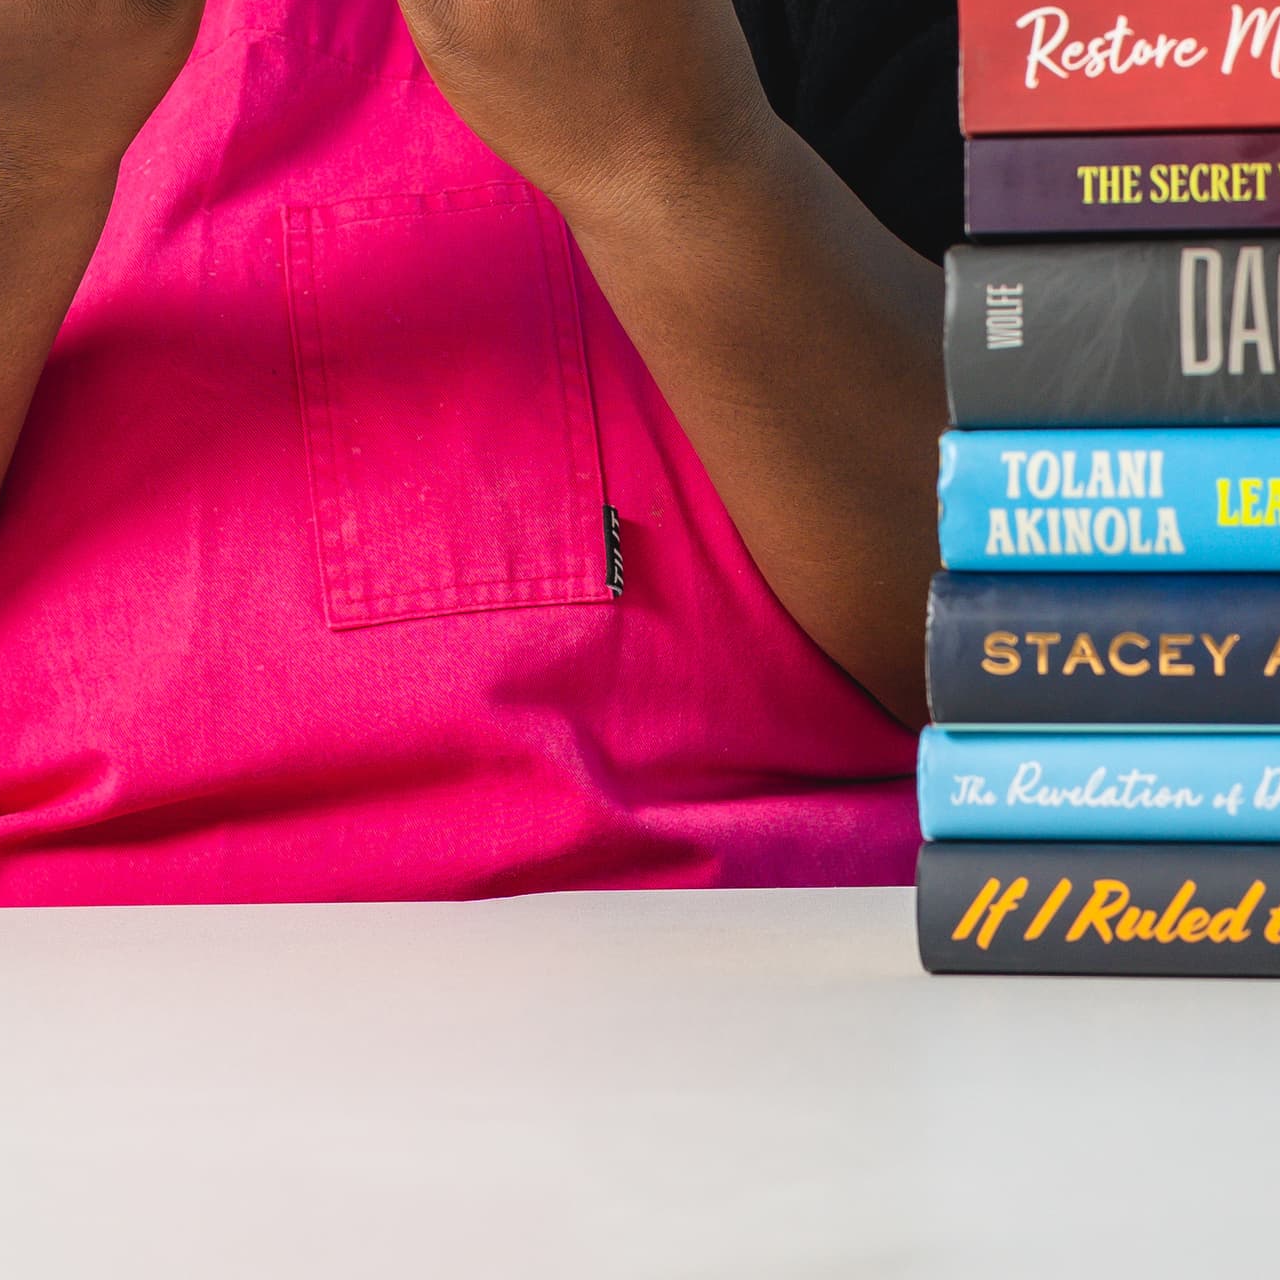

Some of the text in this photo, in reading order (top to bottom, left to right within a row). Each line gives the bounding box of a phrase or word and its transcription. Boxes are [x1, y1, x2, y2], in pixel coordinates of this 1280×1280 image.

[1016, 5, 1209, 89] Restore
[1076, 164, 1142, 204] THE
[1149, 162, 1272, 203] SECRET
[986, 283, 1024, 350] WOLFE
[1001, 450, 1166, 499] TOLANI
[985, 507, 1186, 556] AKINOLA
[981, 632, 1242, 677] STACEY
[950, 775, 997, 809] The
[1006, 761, 1205, 810] Revelation
[1212, 781, 1245, 816] of
[951, 877, 1028, 950] If
[1023, 878, 1073, 942] I
[1065, 878, 1266, 946] Ruled
